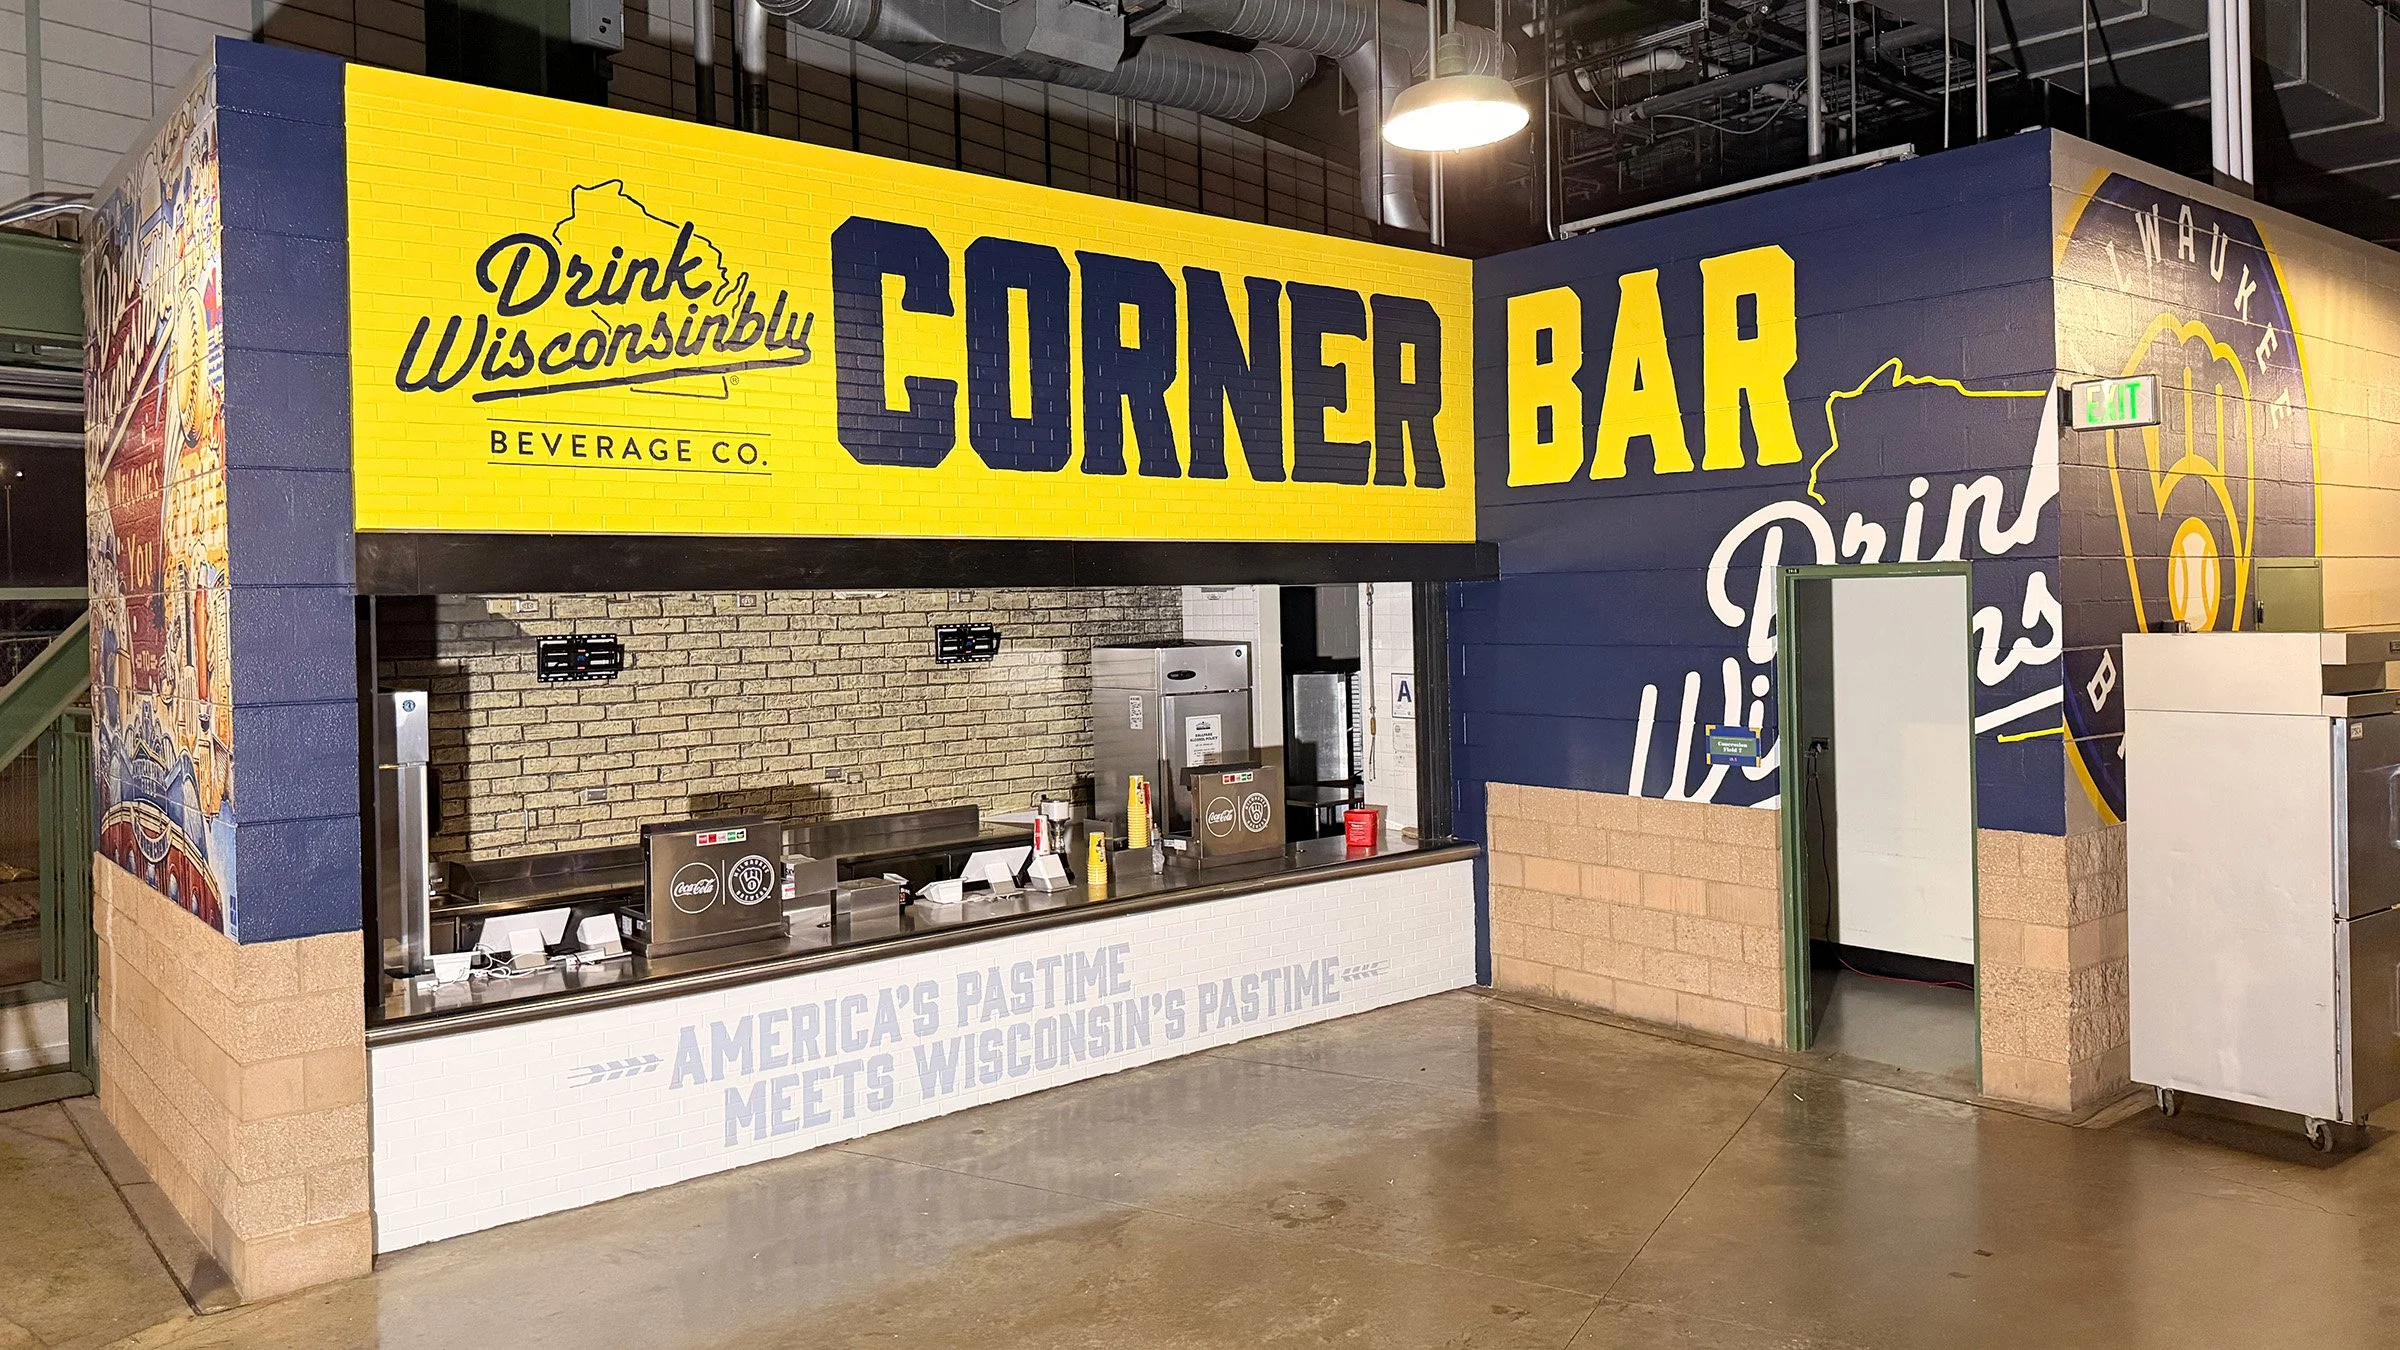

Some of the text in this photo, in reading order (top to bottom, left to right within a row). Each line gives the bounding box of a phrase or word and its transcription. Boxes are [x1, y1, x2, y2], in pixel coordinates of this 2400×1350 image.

[476, 221, 711, 317] Drink
[395, 290, 815, 402] Wisconsinbly
[831, 215, 1803, 488] CORNER BAR
[490, 430, 768, 466] BEVERAGE CO.
[2086, 382, 2141, 424] EXIT
[114, 459, 159, 507] WELCOMES
[1397, 680, 1412, 702] A
[669, 942, 1132, 1091] AMERICA'S PASTIME
[724, 956, 1341, 1148] MEETS WISCONSIN'S PASTIME
